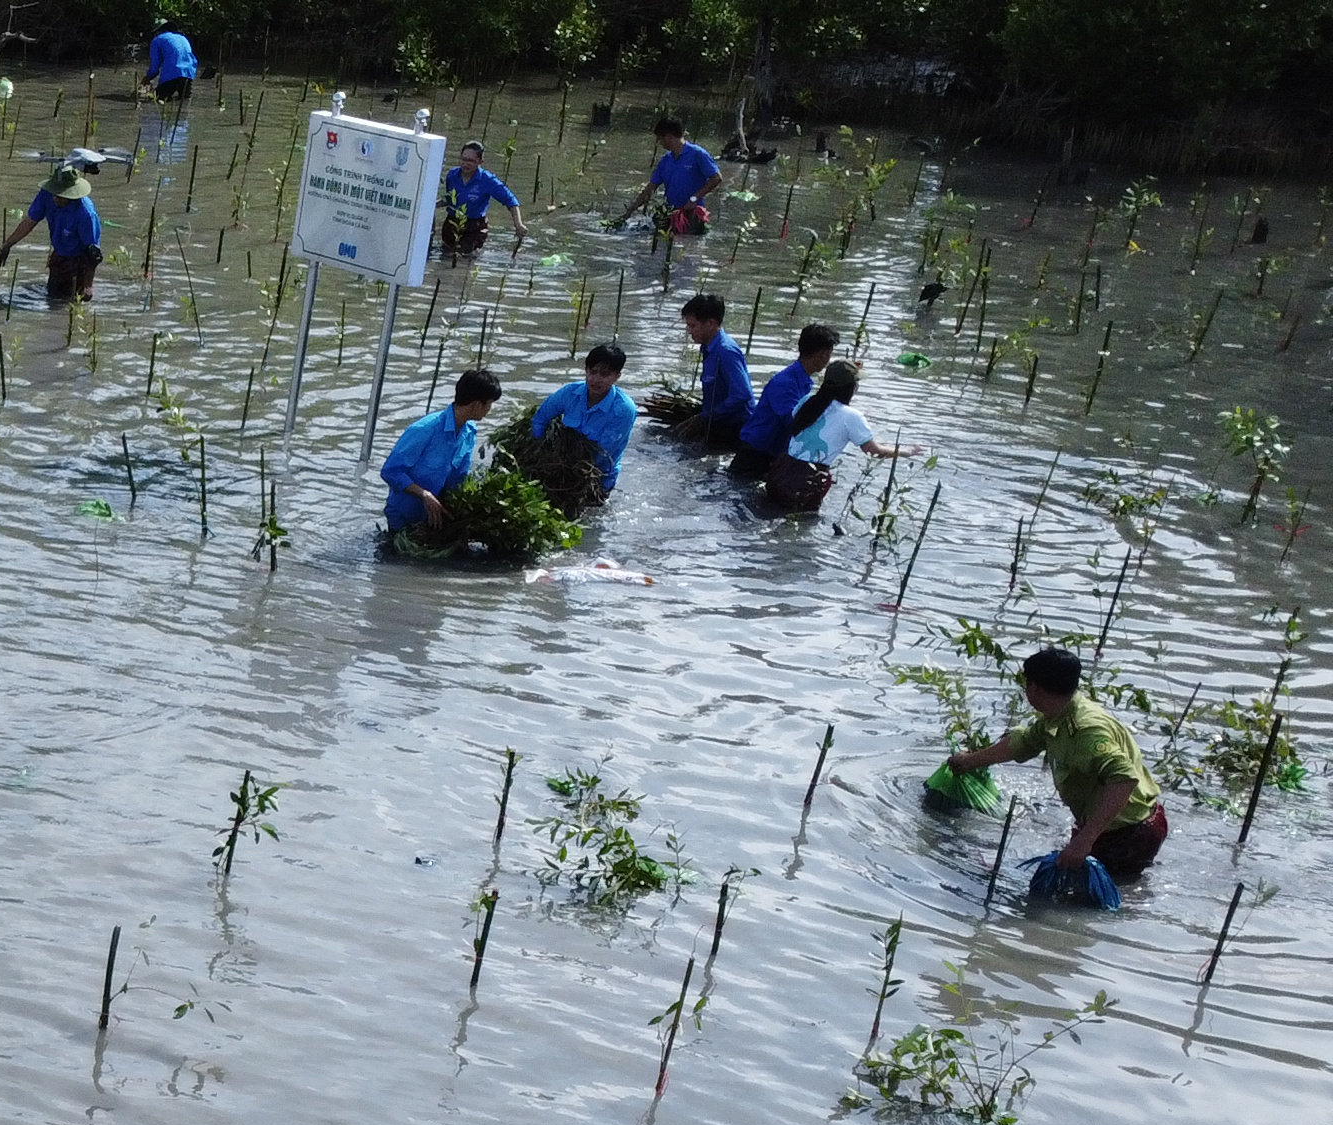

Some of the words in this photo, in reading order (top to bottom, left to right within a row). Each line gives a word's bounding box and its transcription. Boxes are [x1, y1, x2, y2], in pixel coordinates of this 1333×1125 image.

[325, 164, 342, 176] CÔNG
[344, 169, 362, 180] TRÌNH
[386, 178, 399, 189] CÂY
[350, 183, 363, 200] MỘT
[365, 187, 378, 204] VIỆT
[378, 192, 393, 206] NAM
[338, 242, 357, 259] OMO
